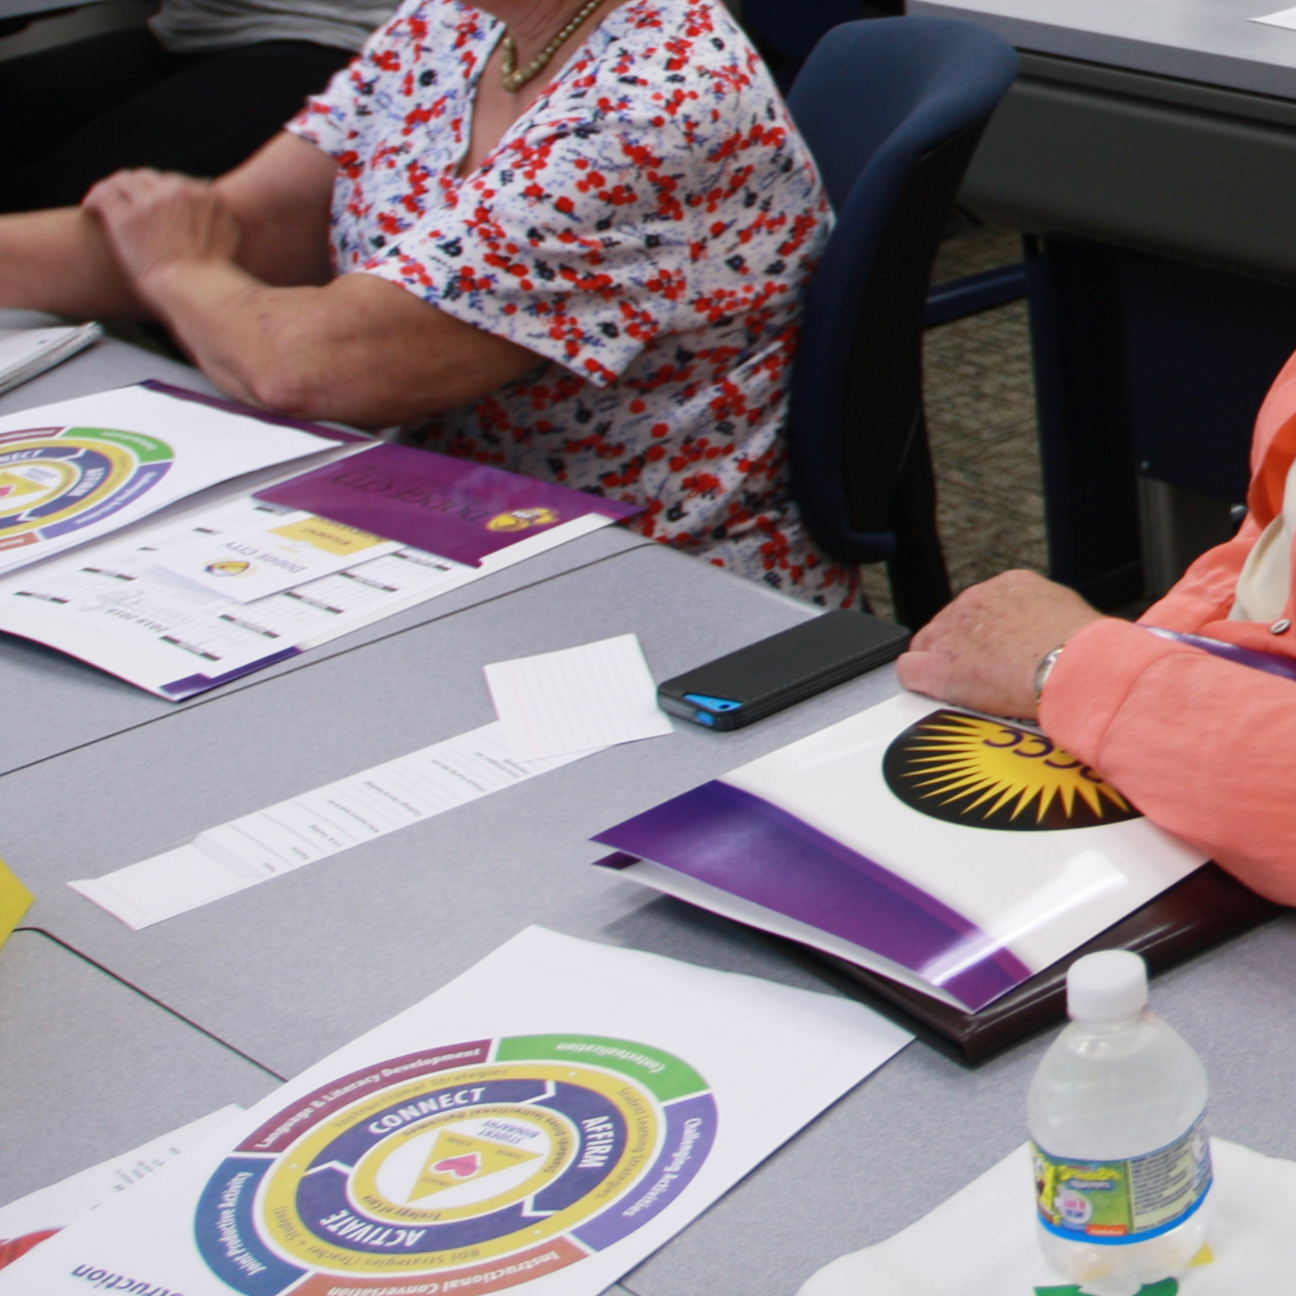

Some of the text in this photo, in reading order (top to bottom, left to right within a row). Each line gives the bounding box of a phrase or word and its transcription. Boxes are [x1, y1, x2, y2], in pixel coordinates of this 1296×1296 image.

[254, 1103, 315, 1149] Language
[322, 1072, 382, 1103] Literacy
[381, 1047, 482, 1078] Development
[367, 1086, 486, 1134] CONNECT
[577, 1115, 615, 1168] AFFIRM
[215, 1171, 254, 1209] Activity
[622, 1117, 702, 1218] Challenging Activities
[214, 1208, 247, 1258] Productive
[319, 1209, 427, 1247] ACTIVATE
[327, 1250, 560, 1296] Instructional Conversation
